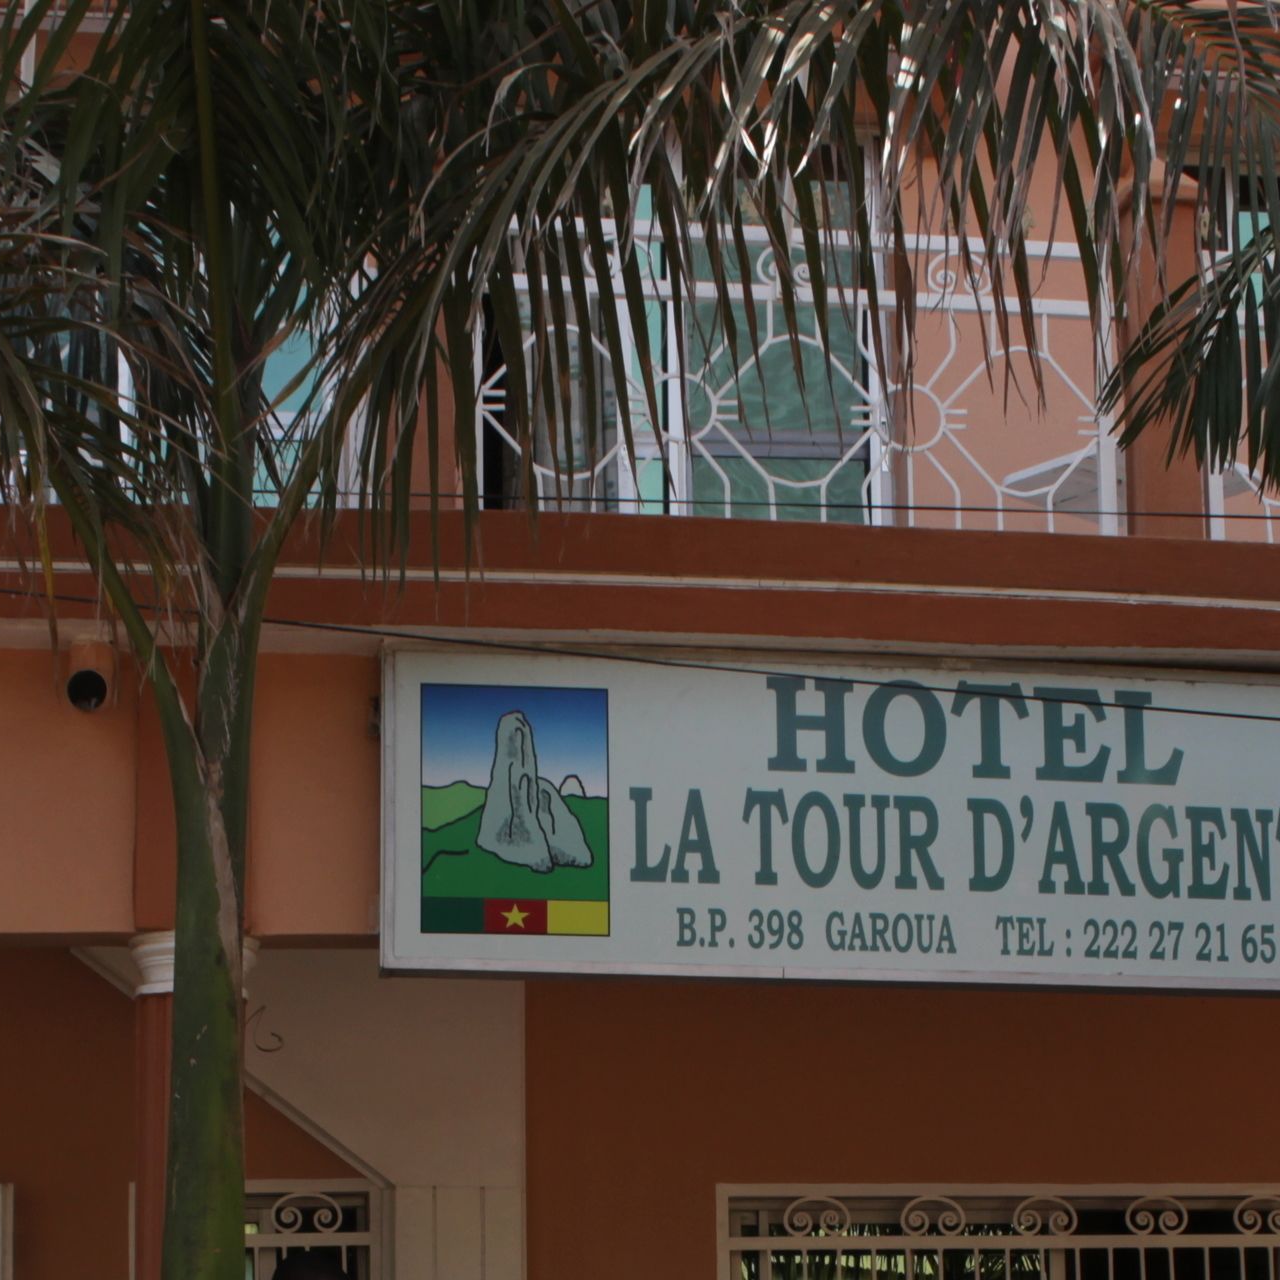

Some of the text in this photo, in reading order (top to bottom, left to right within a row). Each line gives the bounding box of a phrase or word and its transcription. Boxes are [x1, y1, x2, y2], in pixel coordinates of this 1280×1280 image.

[766, 675, 1185, 786] HOTEL
[629, 786, 721, 884] LA
[742, 787, 945, 890] TOUR
[676, 907, 735, 948] B.P.
[747, 908, 805, 950] 398
[825, 910, 958, 954] GAROUA
[1083, 918, 1139, 960] 222
[1149, 920, 1185, 961] 27
[1195, 921, 1230, 962] 21
[1241, 923, 1277, 962] 65
